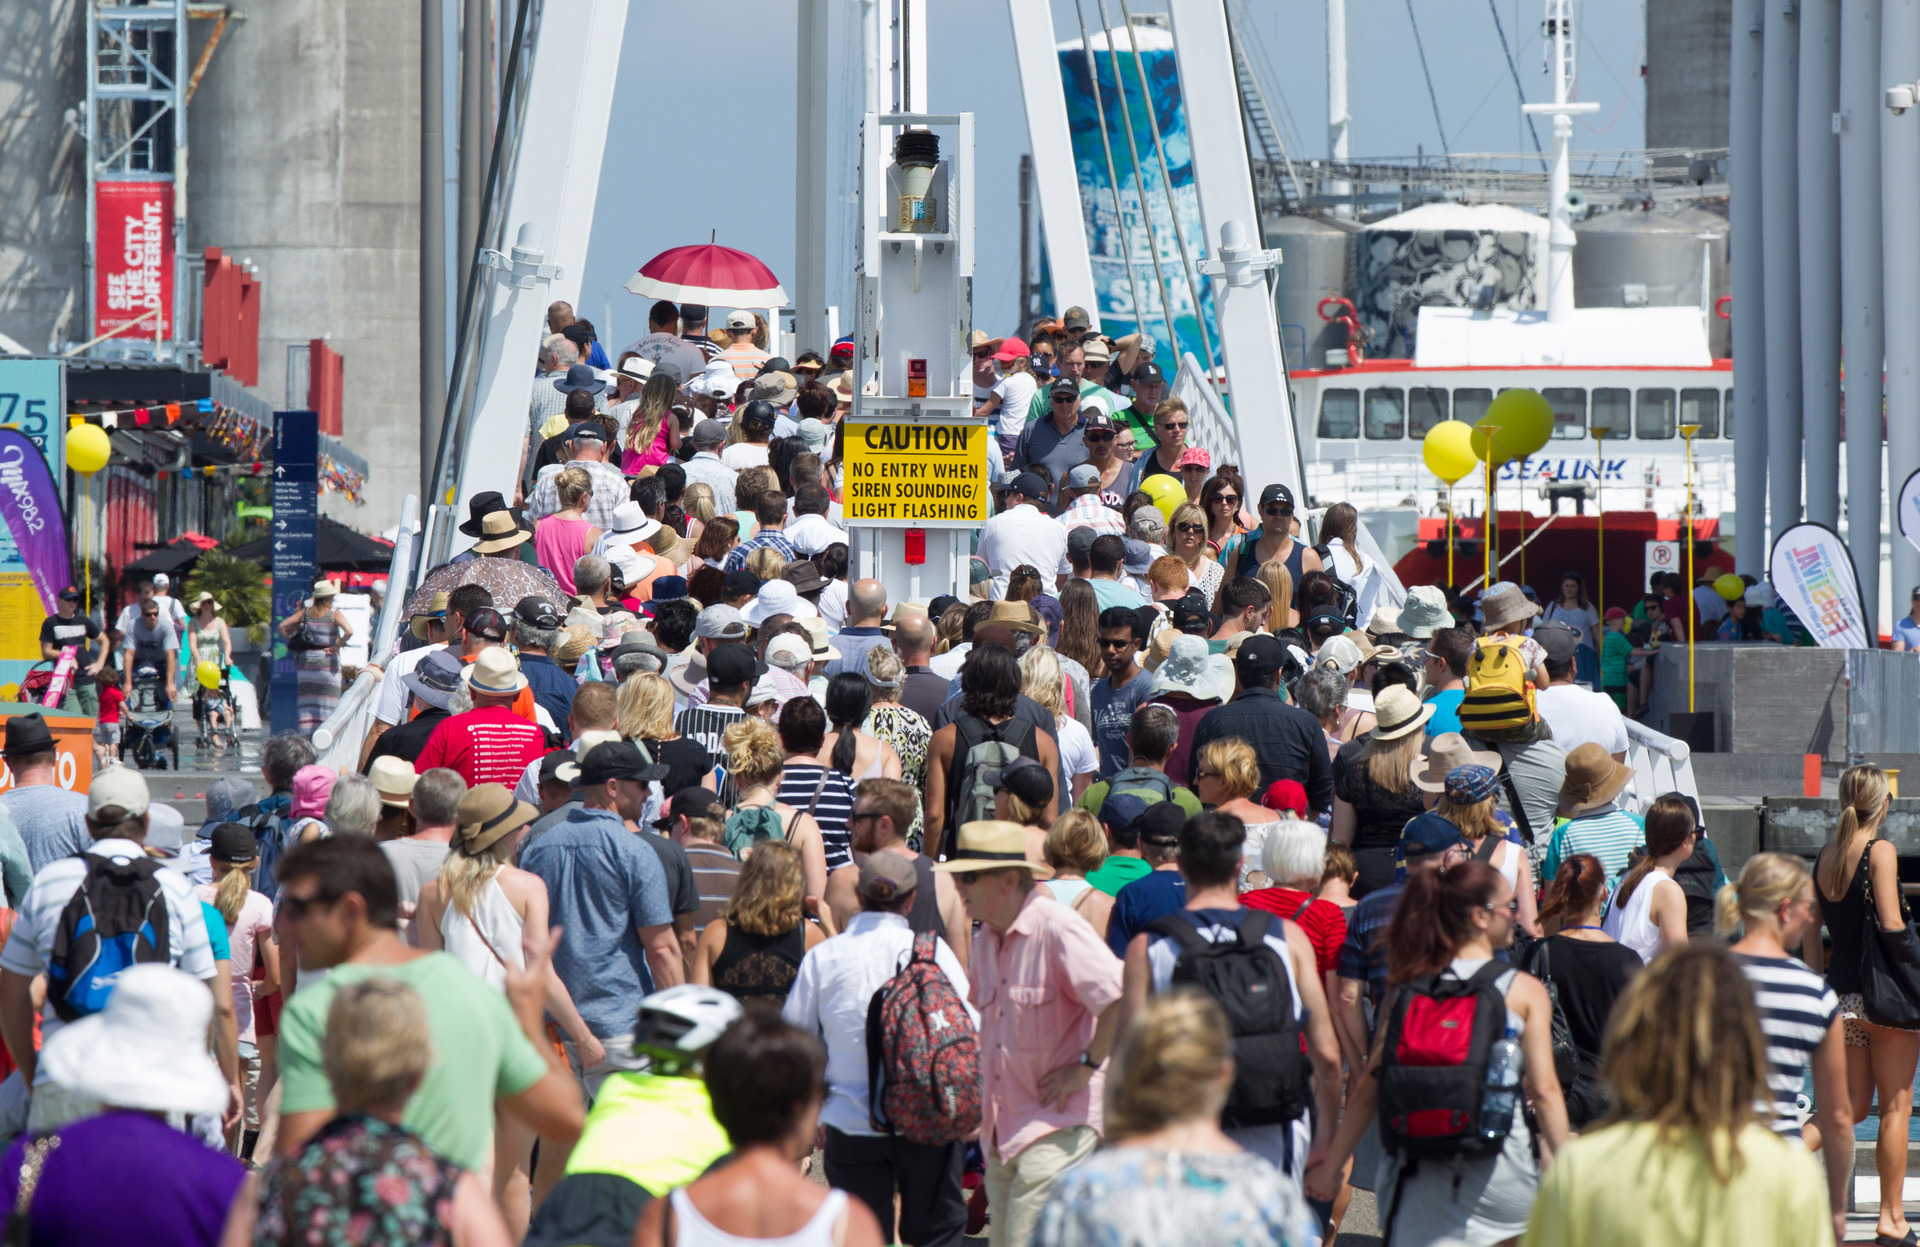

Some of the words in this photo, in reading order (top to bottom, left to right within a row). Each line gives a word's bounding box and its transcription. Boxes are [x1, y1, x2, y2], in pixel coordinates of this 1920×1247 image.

[124, 215, 144, 267] CITY
[143, 200, 162, 309] DIFFERENT.
[108, 272, 126, 310] SEE
[126, 268, 144, 311] THE
[865, 425, 968, 451] CAUTION
[853, 462, 874, 477] NO
[881, 463, 928, 478] ENTRY
[933, 463, 979, 479] WHEN
[1500, 458, 1627, 480] SEALINK
[852, 482, 891, 498] SIREN
[895, 483, 979, 501] SOUNDING/
[852, 502, 897, 518] LIGHT
[903, 503, 978, 519] FLASHING
